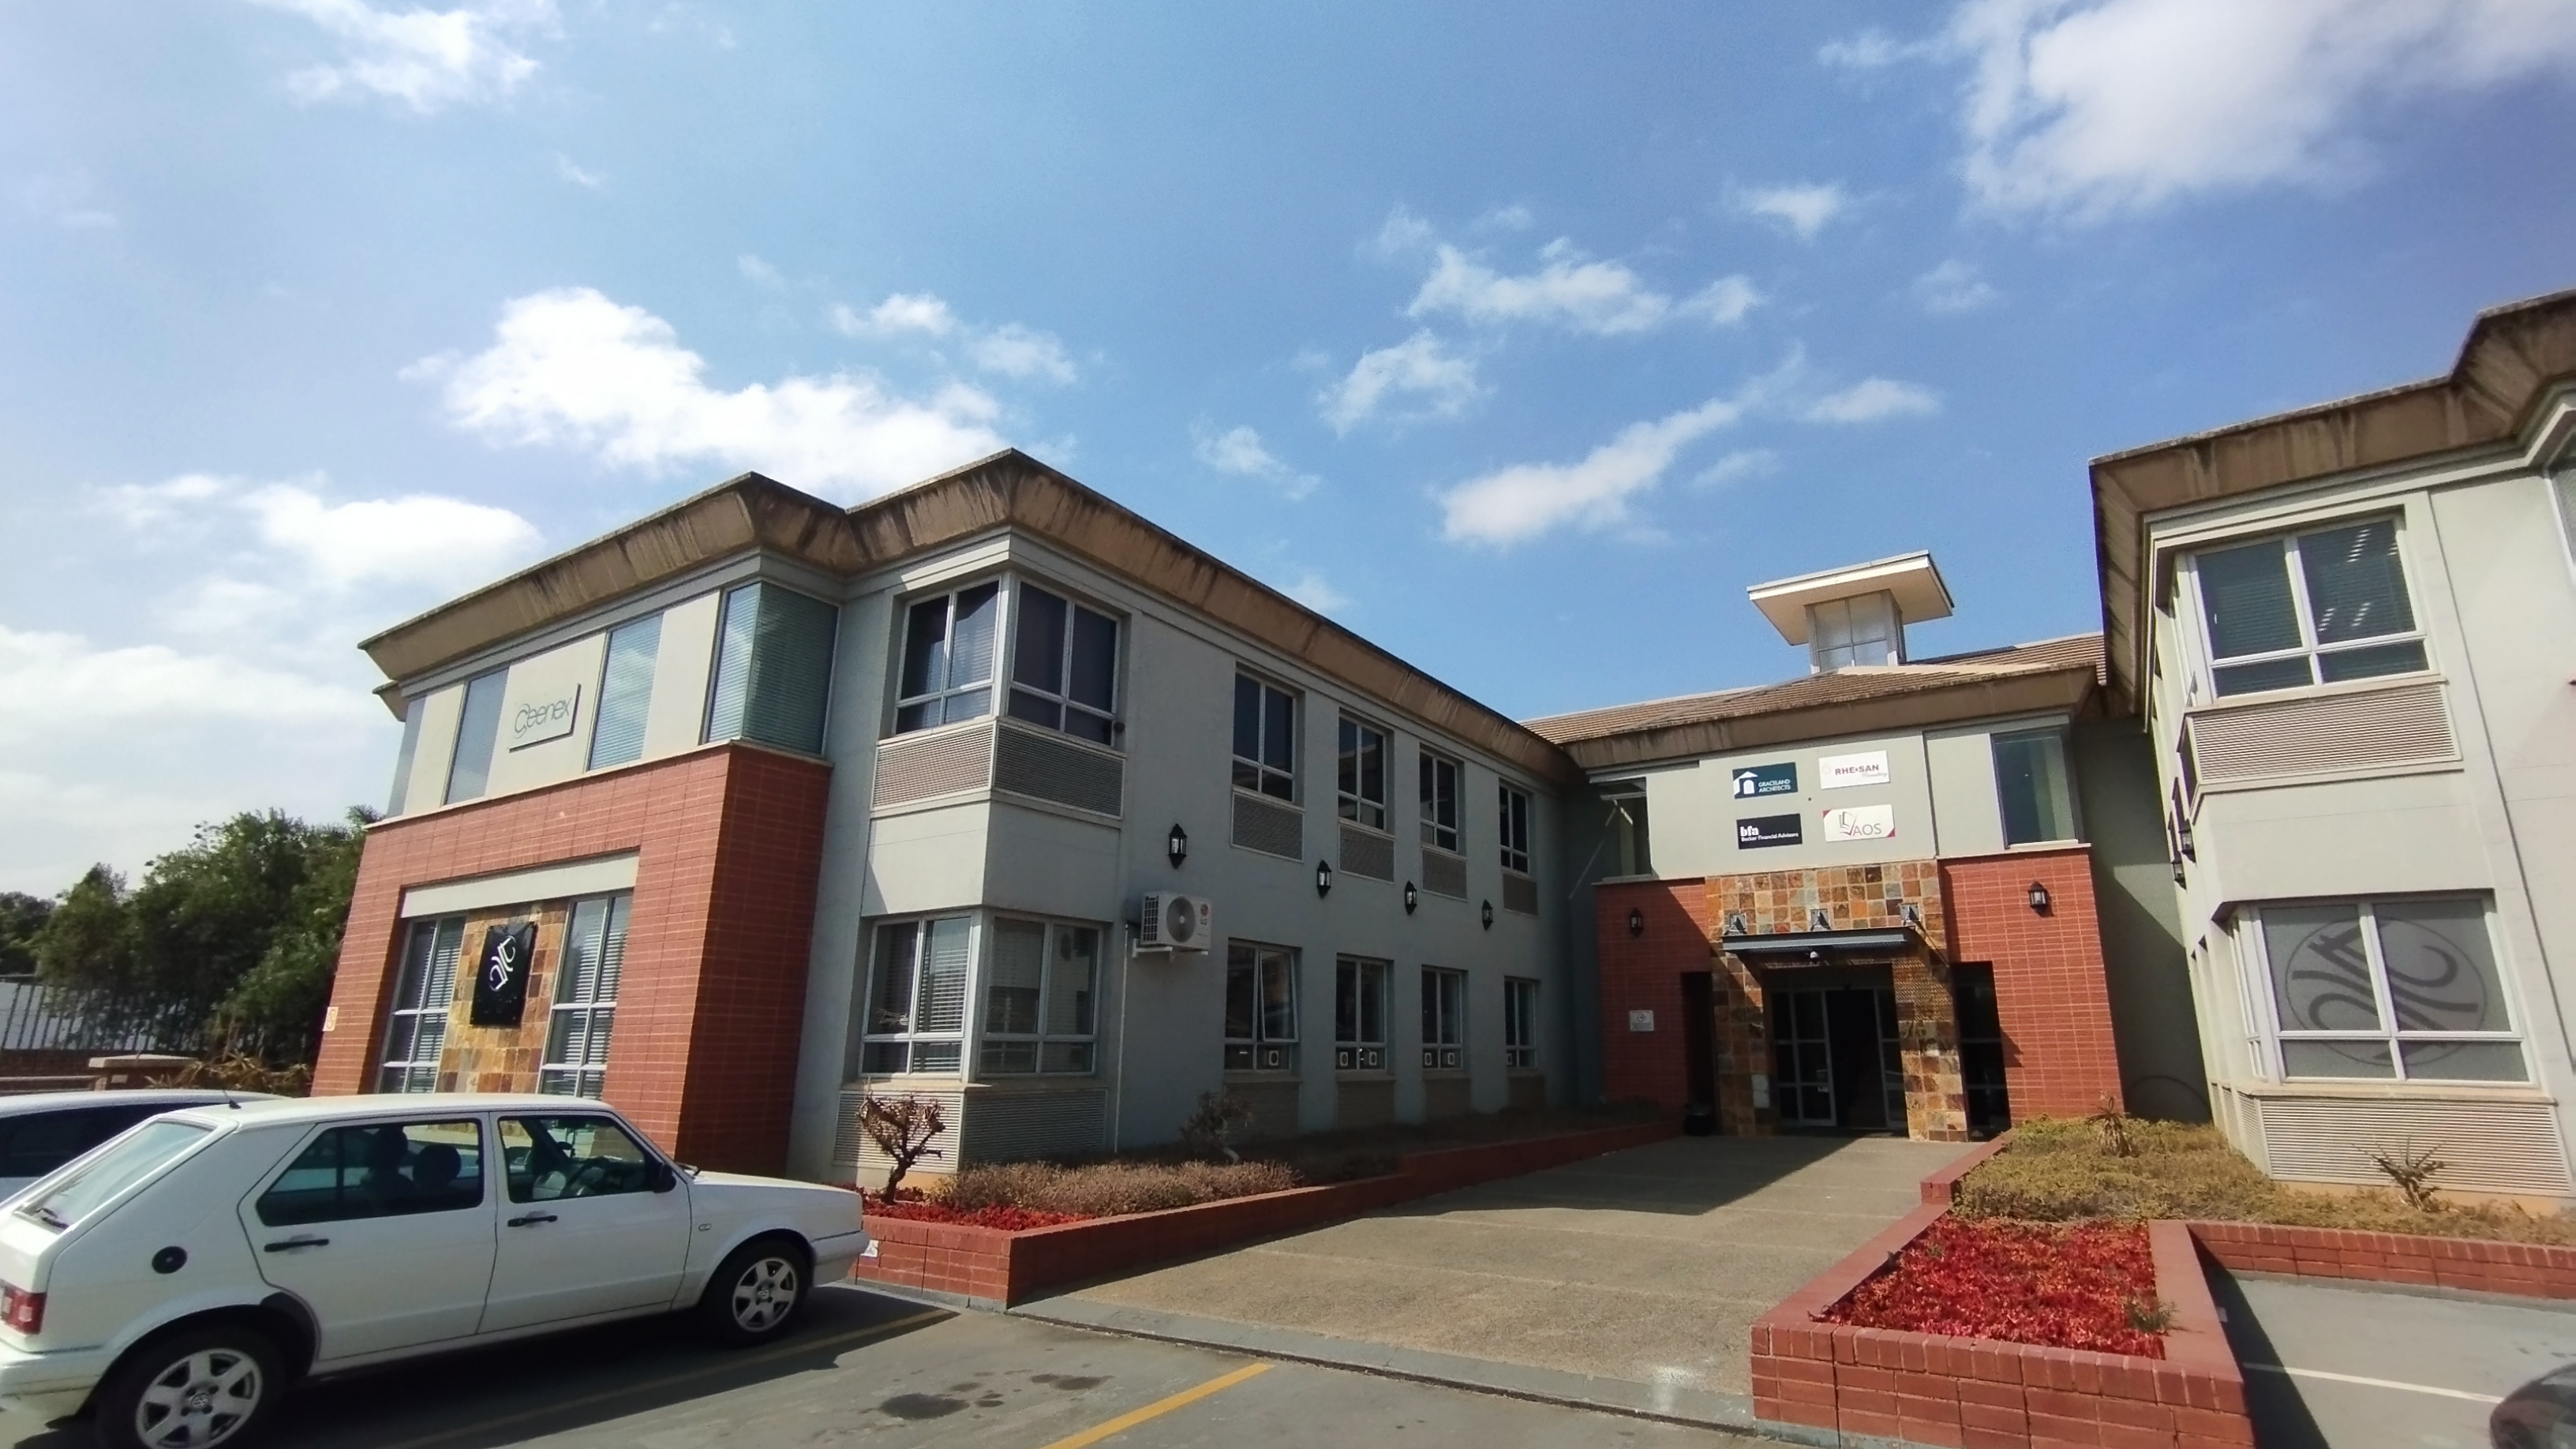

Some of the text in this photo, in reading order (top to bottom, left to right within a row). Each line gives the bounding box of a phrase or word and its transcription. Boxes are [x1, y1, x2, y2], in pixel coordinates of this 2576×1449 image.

[1758, 778, 1791, 788] GRACELAND
[1758, 784, 1792, 793] ARCHITECTS
[1740, 826, 1759, 837] bfa
